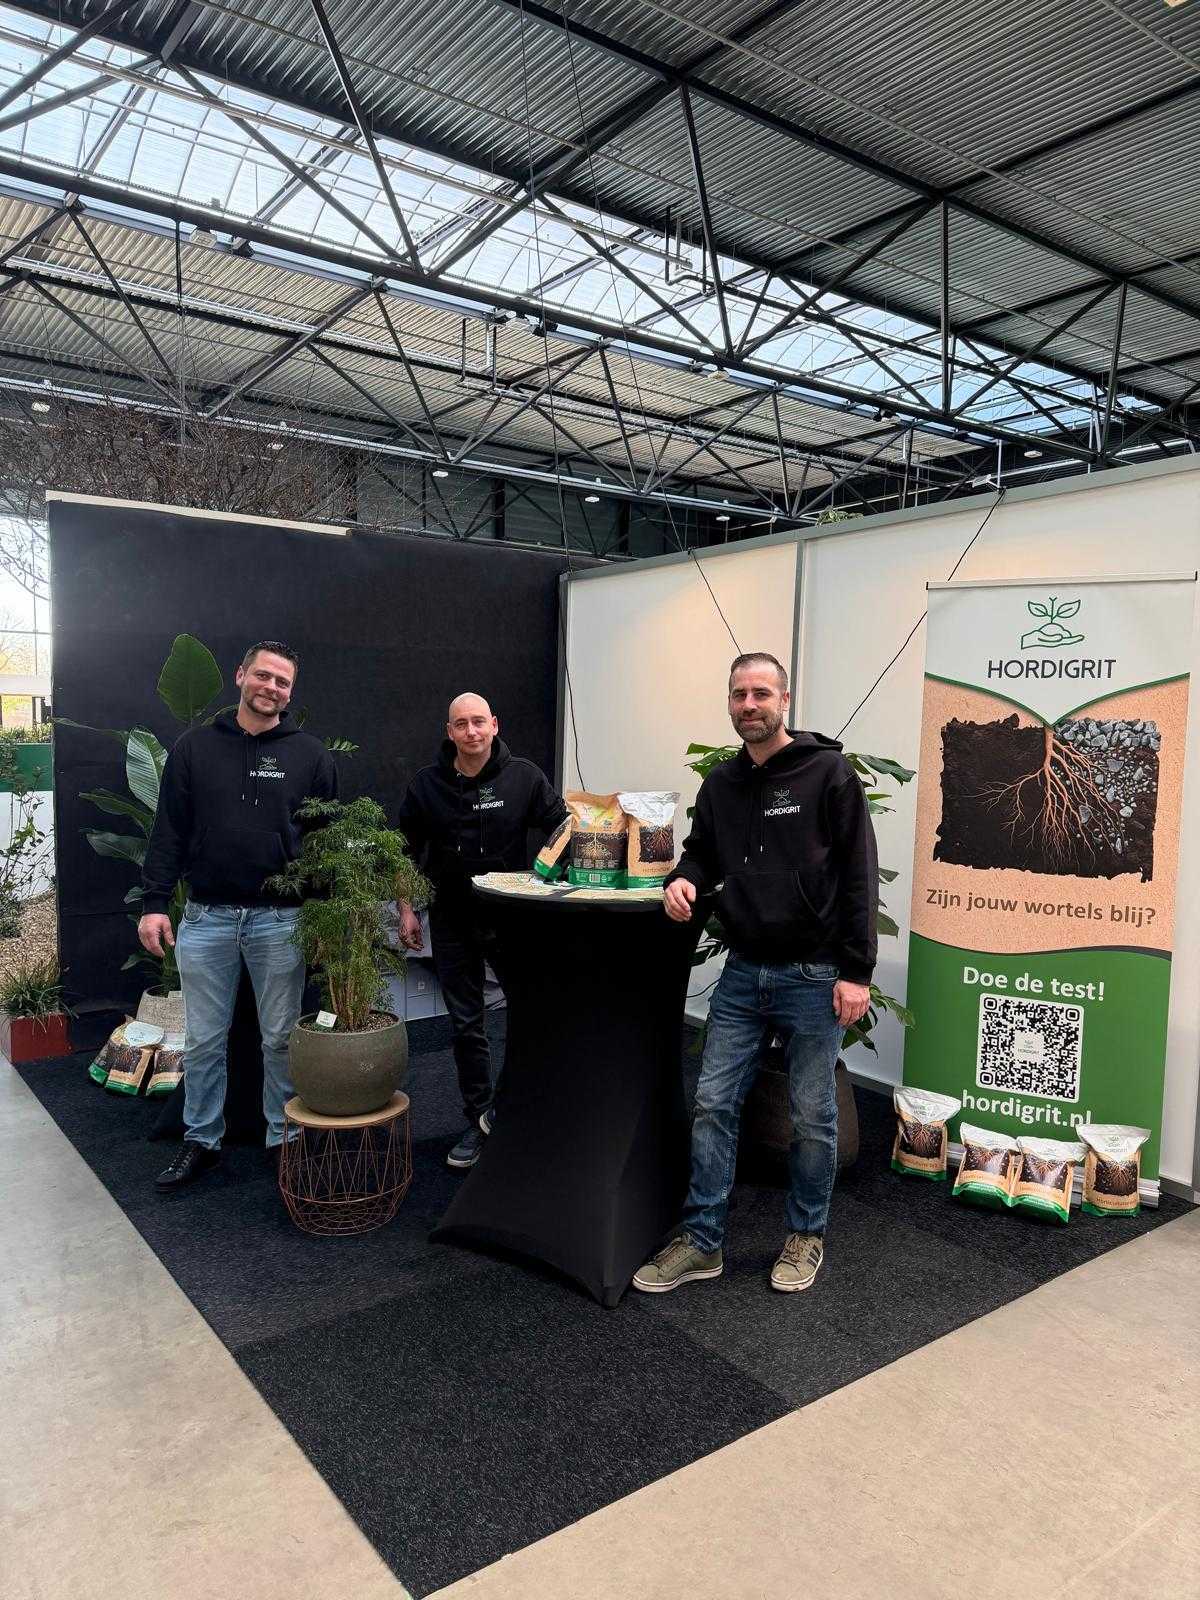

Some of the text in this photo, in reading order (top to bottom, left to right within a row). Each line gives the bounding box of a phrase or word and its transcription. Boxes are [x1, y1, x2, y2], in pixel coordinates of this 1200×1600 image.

[988, 659, 1117, 680] HORDIGRIT
[764, 805, 801, 817] HORDIGRIT
[926, 888, 1156, 928] Zijn jouw wortels blij?
[963, 966, 1105, 1001] Doe de test!
[962, 1090, 1092, 1128] hordigrit.nl
